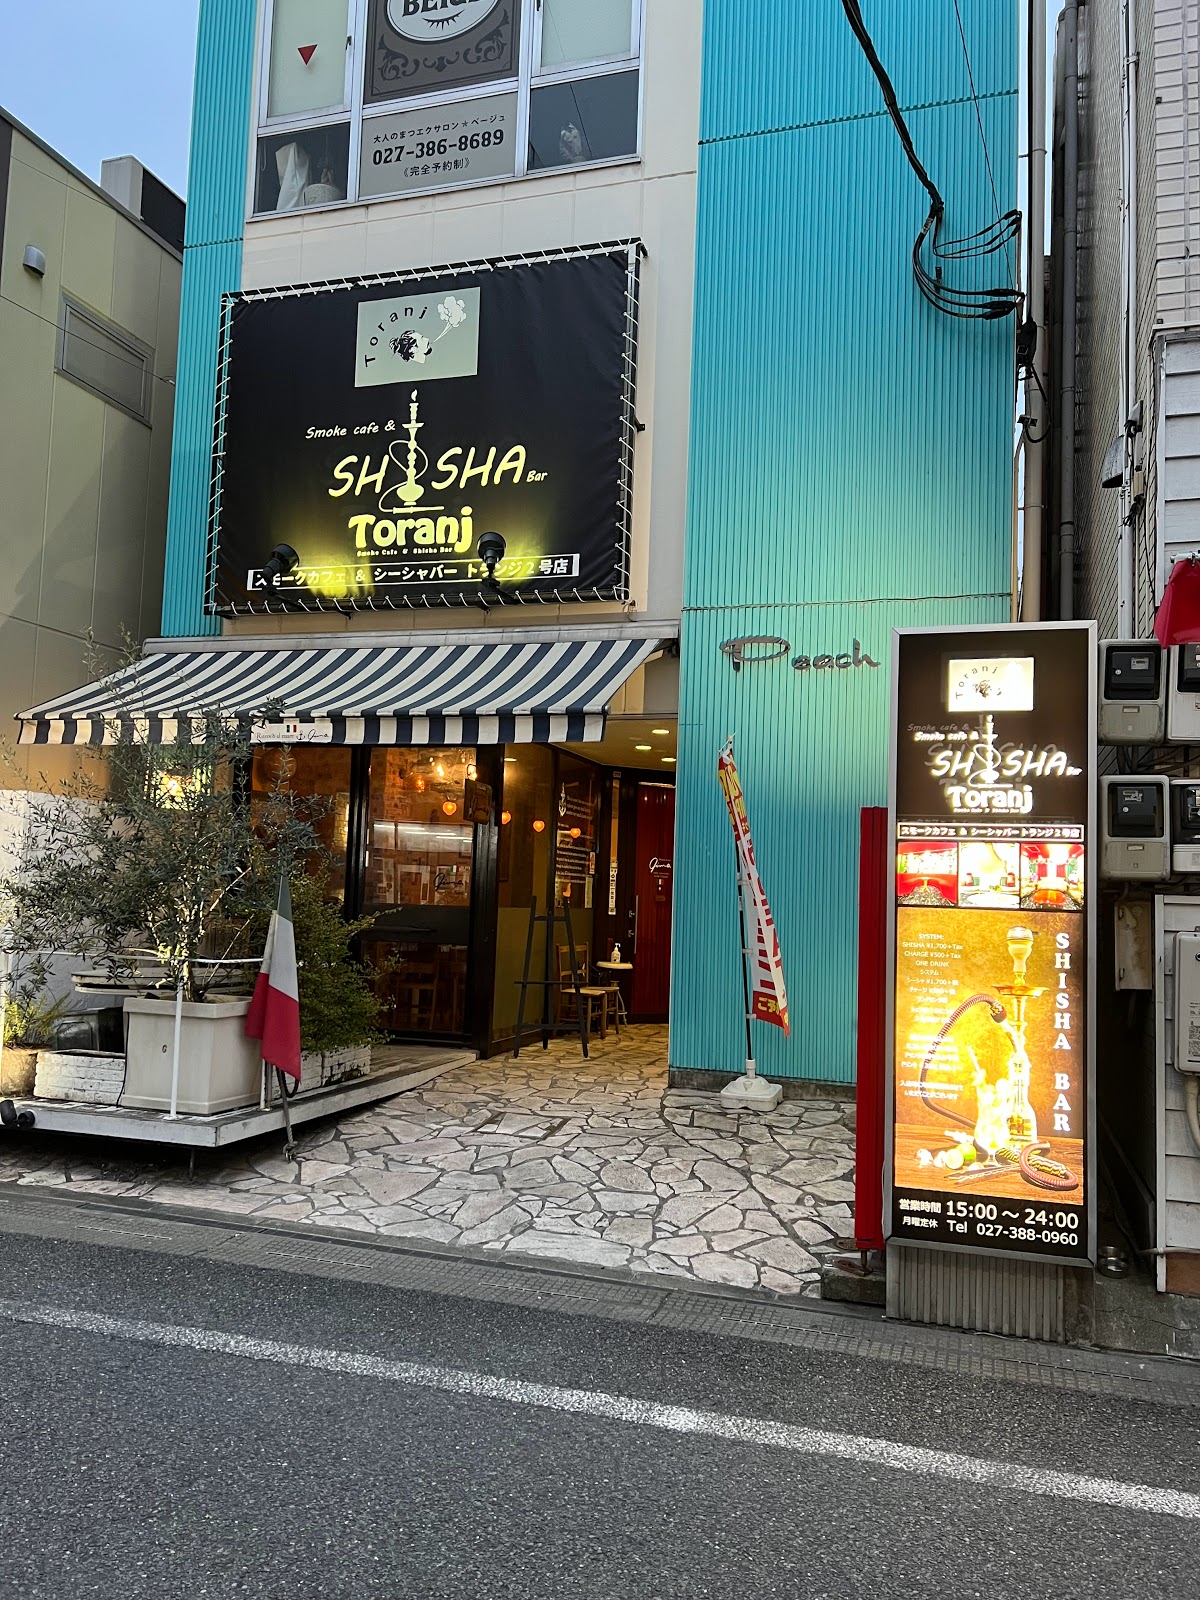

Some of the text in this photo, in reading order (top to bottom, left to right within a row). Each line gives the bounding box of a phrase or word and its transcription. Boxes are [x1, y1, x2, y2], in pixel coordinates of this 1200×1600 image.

[372, 129, 504, 165] 027-386-8689
[364, 306, 428, 368] Toranj
[305, 419, 396, 439] Smoke cafe &
[526, 470, 548, 482] Bar
[348, 506, 473, 553] Toranj
[355, 569, 365, 582] &
[373, 564, 457, 582] シーシャバー
[719, 635, 881, 672] Peach
[955, 665, 999, 700] Toranj
[947, 784, 1033, 814] Toranj
[1053, 932, 1071, 1131] SHISHA BAR
[899, 1199, 942, 1213] 営業時間
[946, 1200, 998, 1221] 15:00
[1024, 1208, 1079, 1229] 24:00
[902, 1215, 1079, 1246] 月曜定休 Tel 027-388-0960
